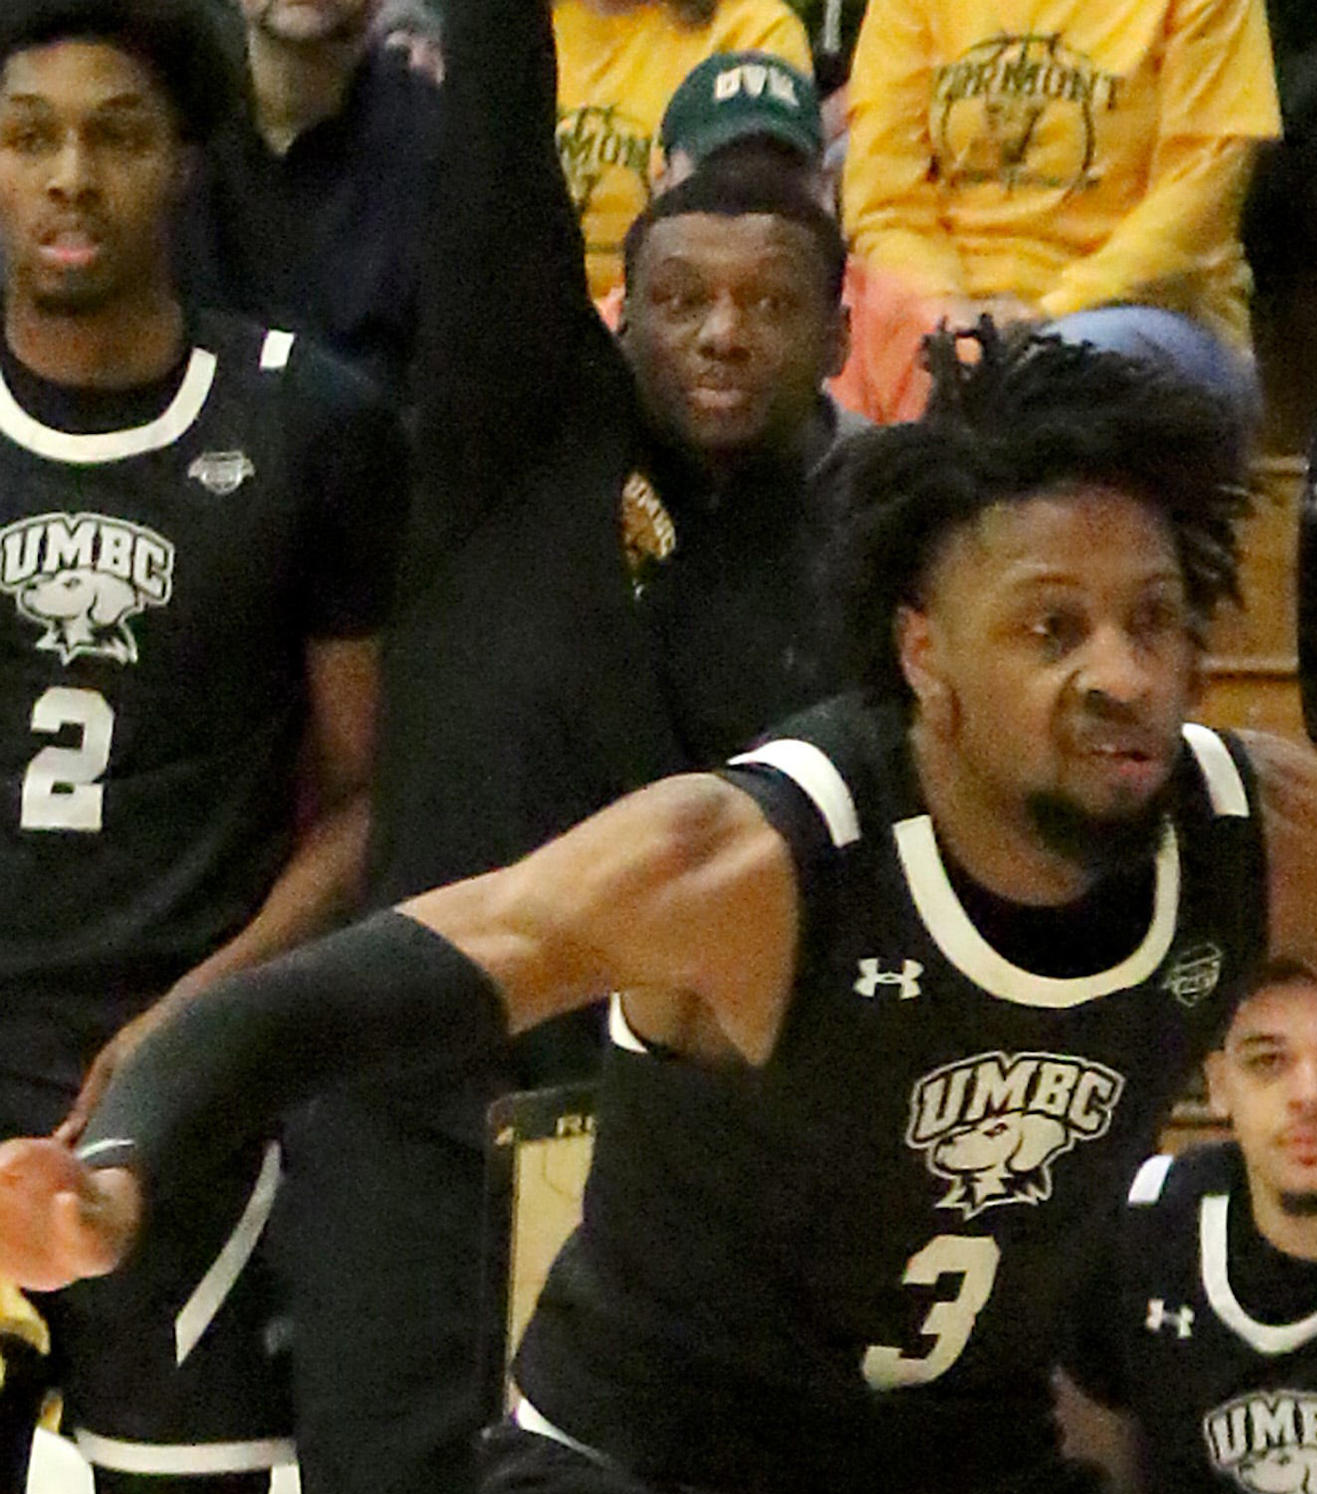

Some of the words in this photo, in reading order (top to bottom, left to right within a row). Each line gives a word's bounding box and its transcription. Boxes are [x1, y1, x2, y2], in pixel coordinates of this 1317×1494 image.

[0, 513, 172, 598] UMBC
[20, 686, 116, 832] 2
[908, 1054, 1120, 1142] UMBC
[860, 1233, 1002, 1390] 3
